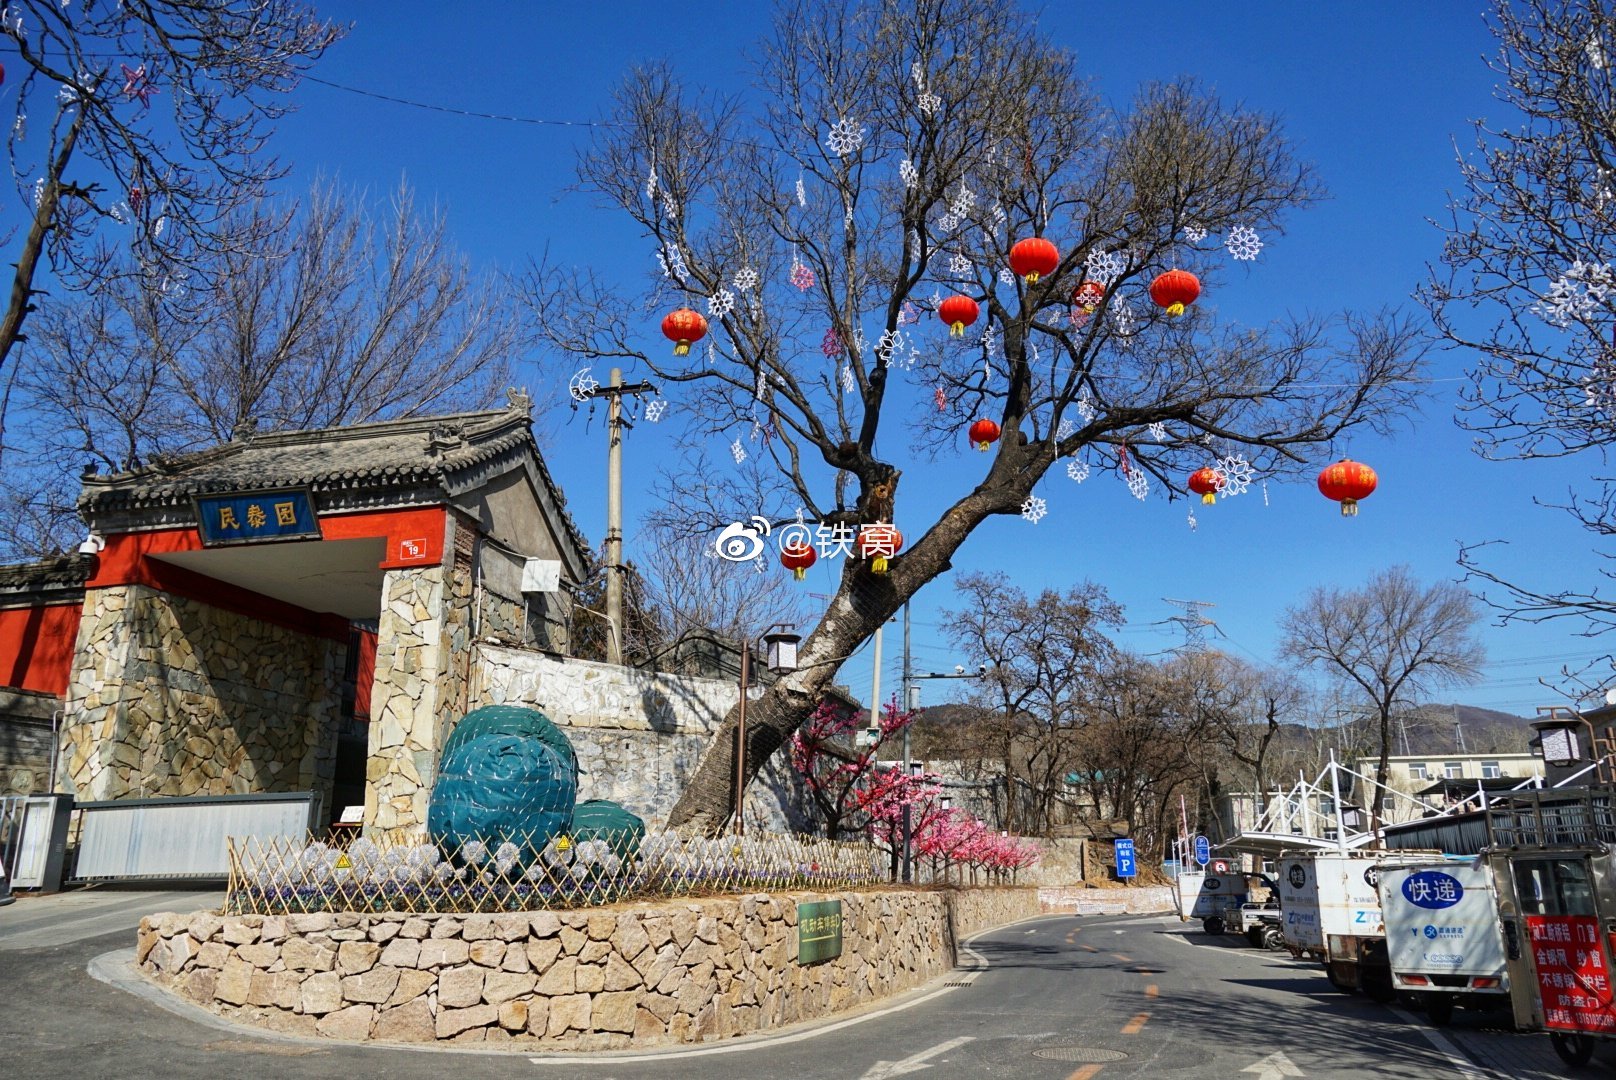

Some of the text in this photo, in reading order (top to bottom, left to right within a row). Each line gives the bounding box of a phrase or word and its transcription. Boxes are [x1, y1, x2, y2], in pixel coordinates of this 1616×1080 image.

[408, 546, 419, 555] 19
[1121, 859, 1131, 872] P
[1408, 879, 1457, 902] 快递
[1576, 949, 1602, 968] 纱窗
[1541, 973, 1608, 991] 不锈钢 护栏
[1558, 994, 1600, 1009] 防盗门
